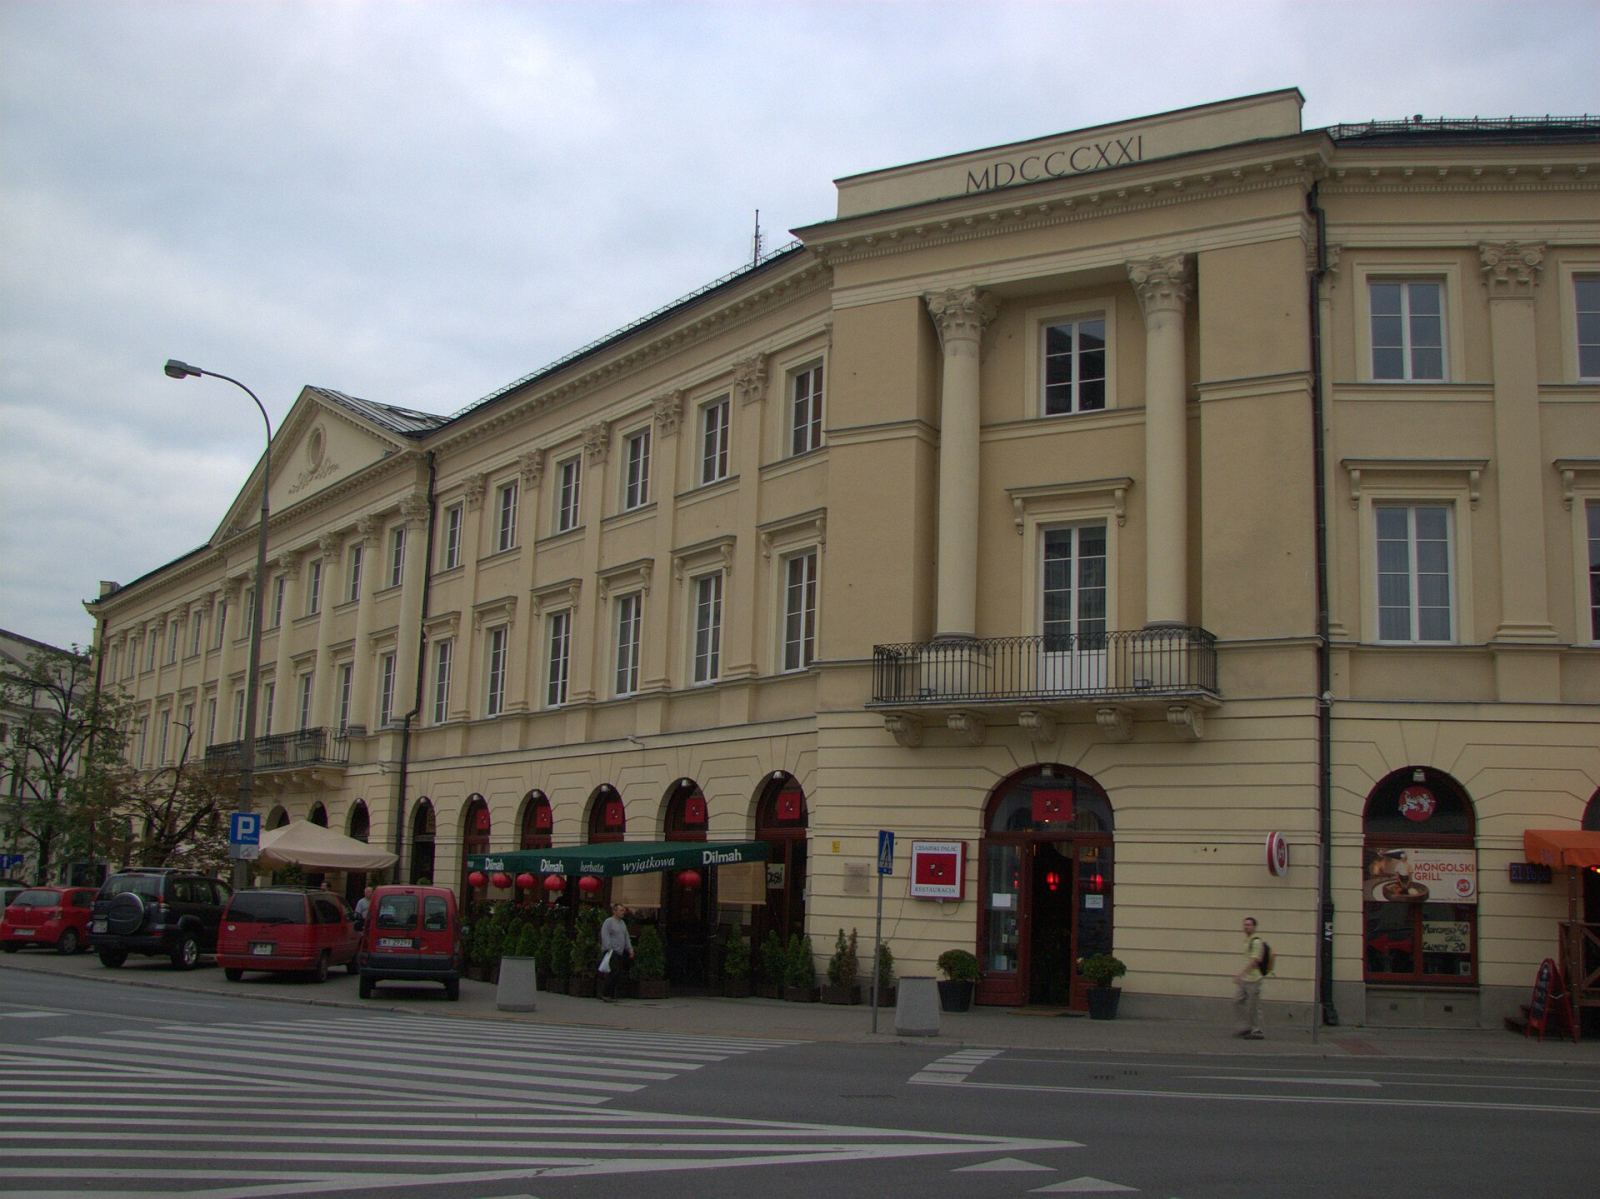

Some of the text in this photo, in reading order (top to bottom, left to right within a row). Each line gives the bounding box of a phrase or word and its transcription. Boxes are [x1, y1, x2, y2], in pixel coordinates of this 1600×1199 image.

[965, 135, 1142, 194] MDCCCXXI
[237, 816, 255, 840] P
[485, 857, 504, 871] Dilmah
[702, 848, 742, 865] Dilmah
[540, 858, 564, 873] Dilmah
[580, 860, 604, 873] herbata
[622, 856, 675, 874] wyjątkowa
[1414, 863, 1475, 873] MONGOLSKI
[1414, 872, 1442, 880] GRILL
